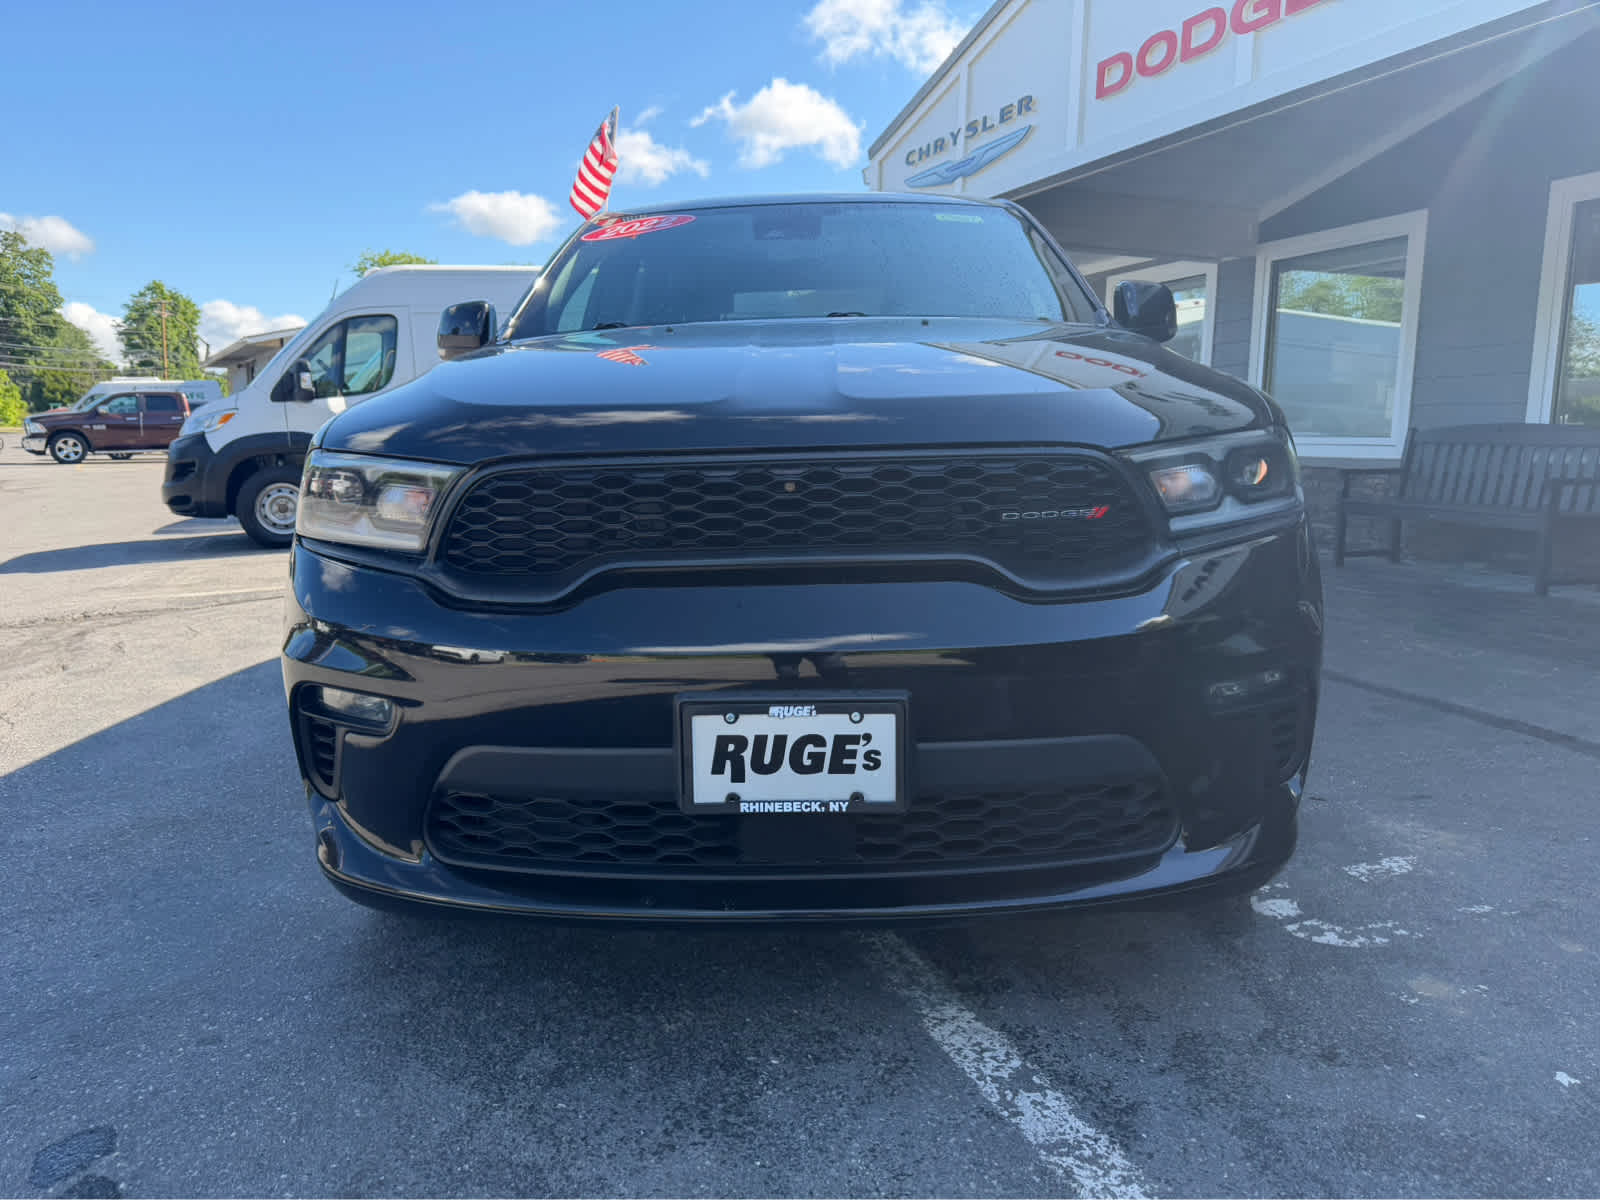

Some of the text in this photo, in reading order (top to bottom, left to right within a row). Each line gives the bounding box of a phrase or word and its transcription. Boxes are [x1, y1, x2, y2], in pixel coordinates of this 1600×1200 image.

[905, 95, 1032, 166] CHRYSLER
[1002, 508, 1098, 520] DODGE
[711, 733, 882, 783] RUGE's
[740, 801, 848, 813] RHINEBECK, NY
